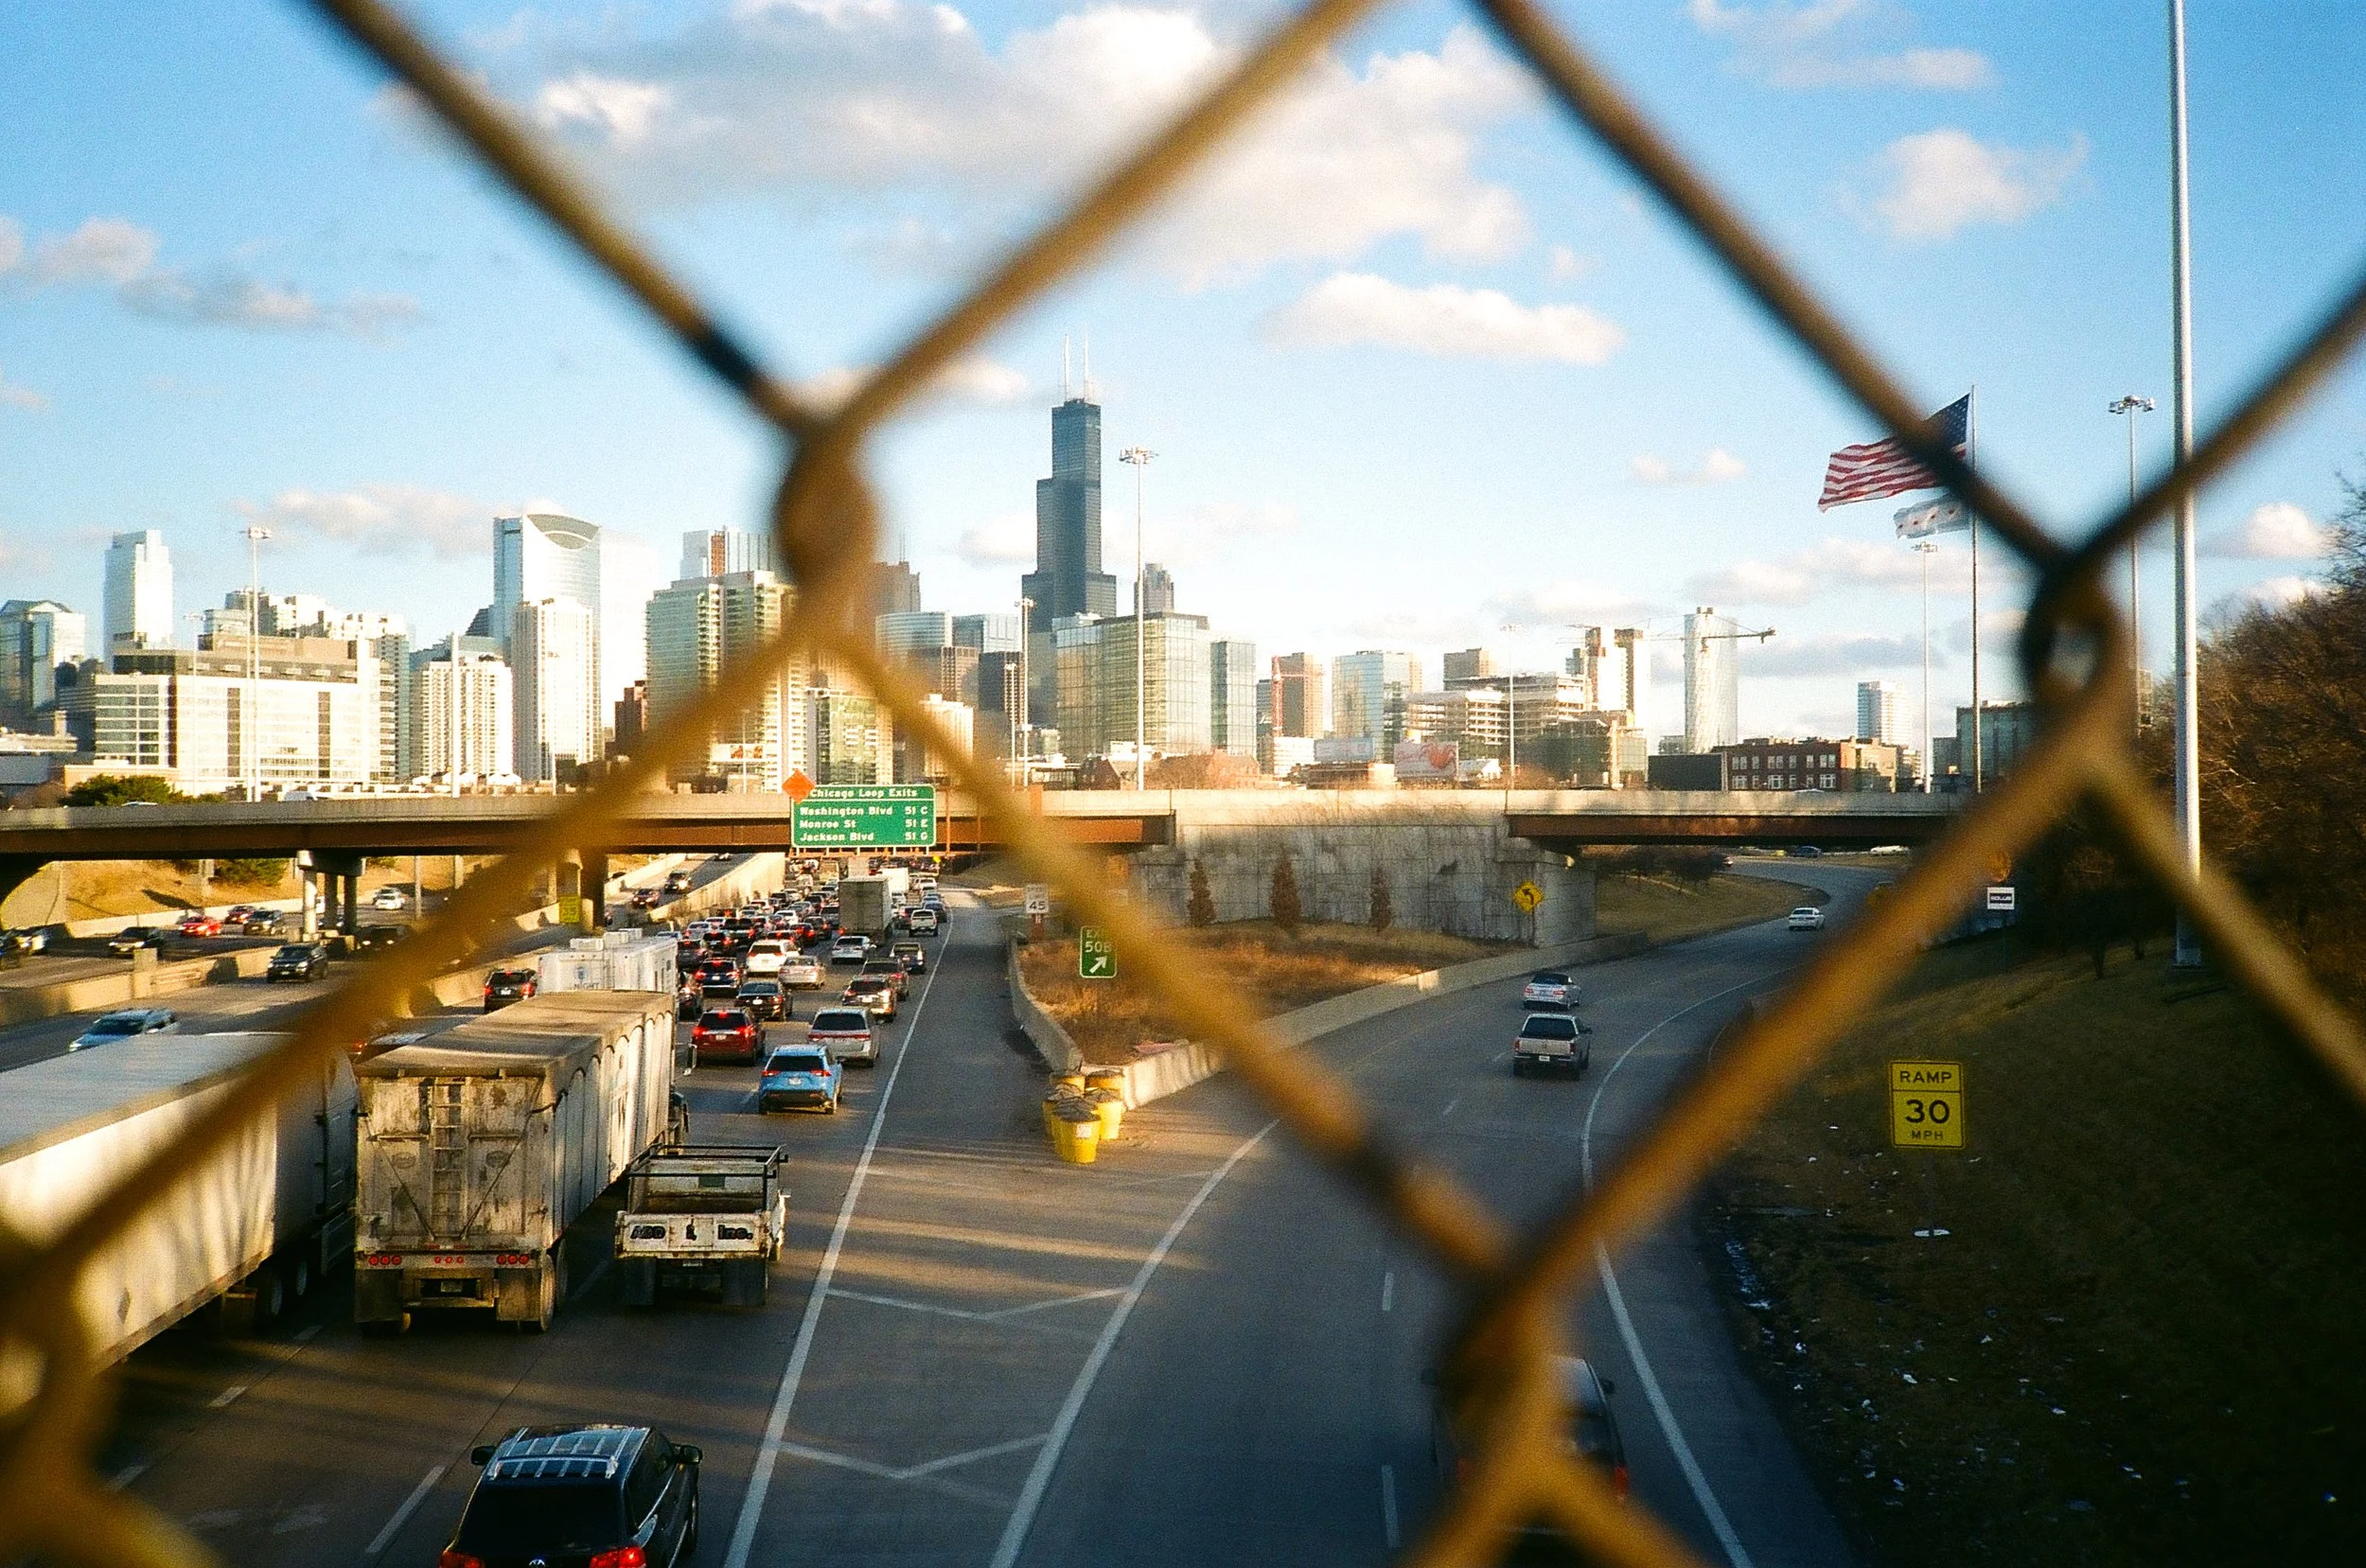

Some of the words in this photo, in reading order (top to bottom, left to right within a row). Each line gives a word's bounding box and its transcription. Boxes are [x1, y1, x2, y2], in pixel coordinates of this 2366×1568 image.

[810, 788, 855, 800] Chicago
[858, 788, 885, 799] Loop
[889, 788, 917, 797] Exits
[800, 806, 864, 818] Washington
[869, 806, 892, 815] Blvd
[905, 806, 916, 815] 51
[920, 806, 927, 815] C
[800, 819, 839, 828] Monroe
[843, 819, 856, 828] St
[905, 819, 916, 828] 51
[920, 819, 928, 828] E
[800, 833, 845, 841] Jackson
[850, 832, 874, 841] Blvd
[905, 832, 916, 840] 51
[1029, 901, 1046, 910] 45
[1085, 941, 1112, 953] 50B
[1899, 1070, 1952, 1084] RAMP
[1905, 1099, 1950, 1124] 30
[1912, 1130, 1943, 1140] MPH
